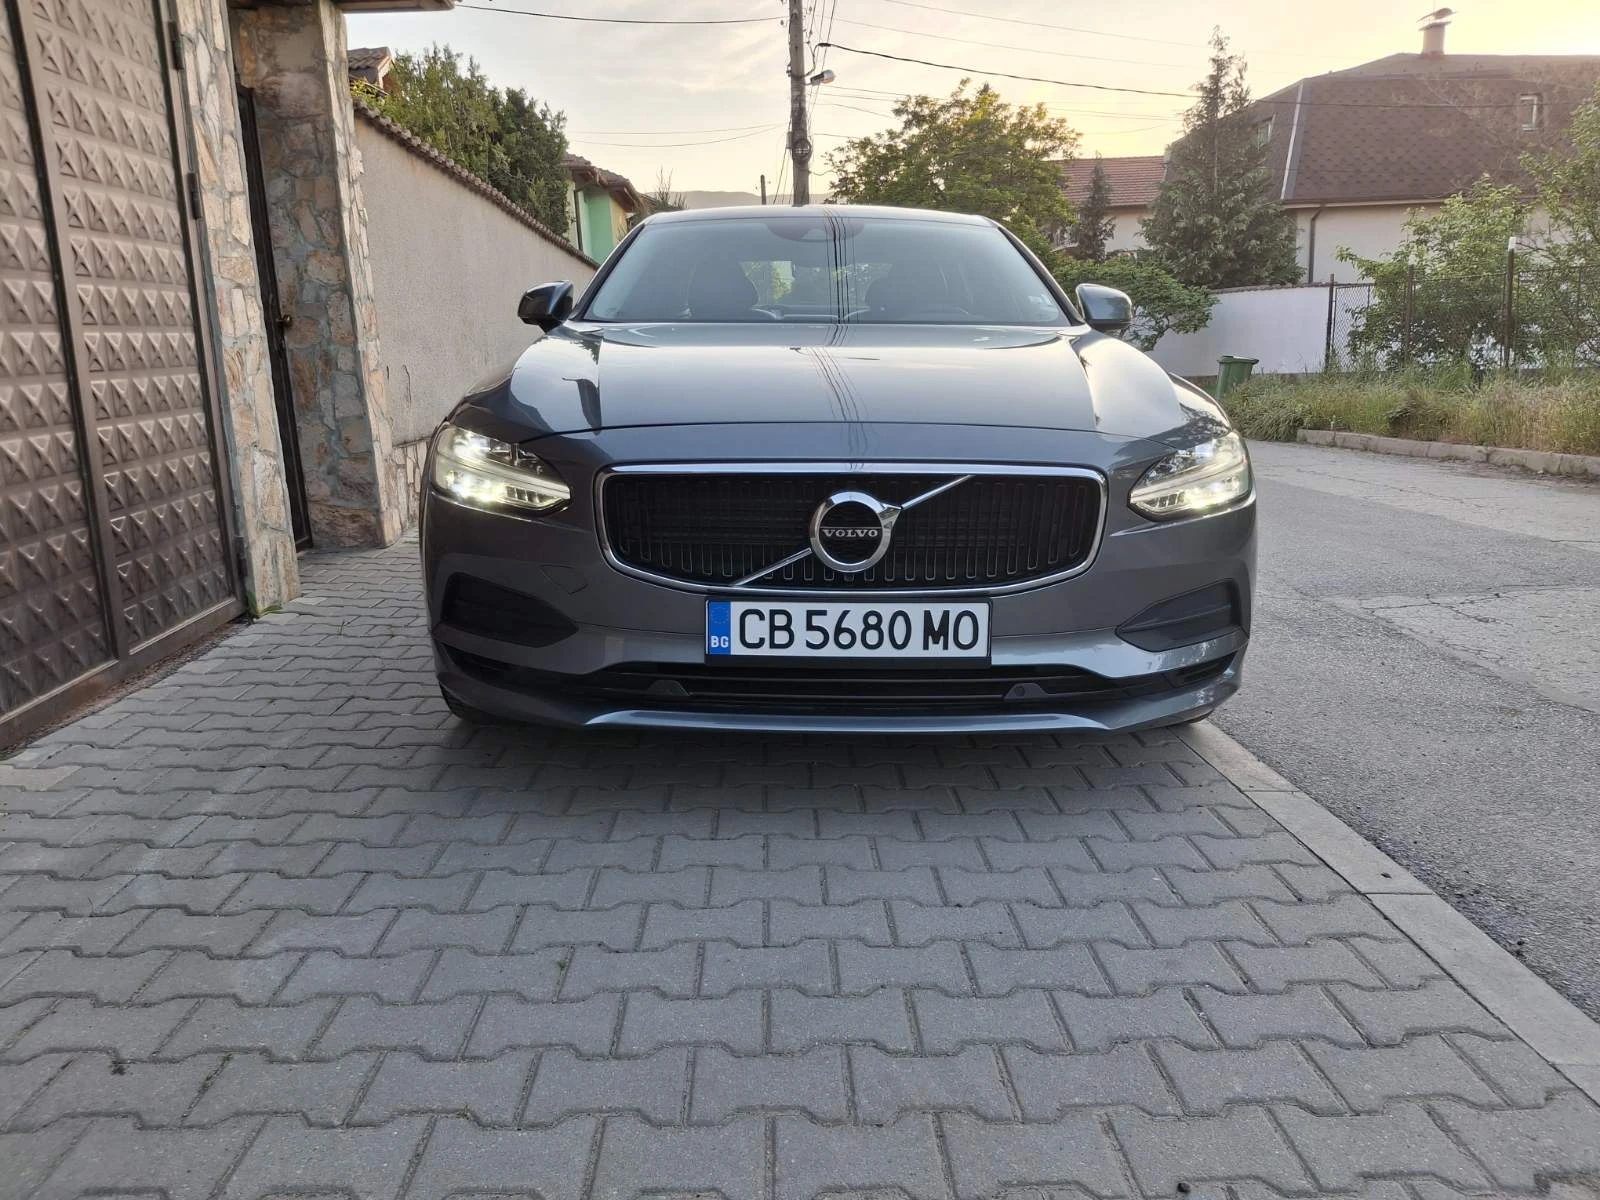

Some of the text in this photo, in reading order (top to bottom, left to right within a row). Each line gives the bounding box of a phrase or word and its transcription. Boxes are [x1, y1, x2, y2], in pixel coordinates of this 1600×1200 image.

[822, 529, 878, 538] VOLVO
[739, 608, 980, 651] CB 5680 MO
[710, 635, 729, 648] BG
